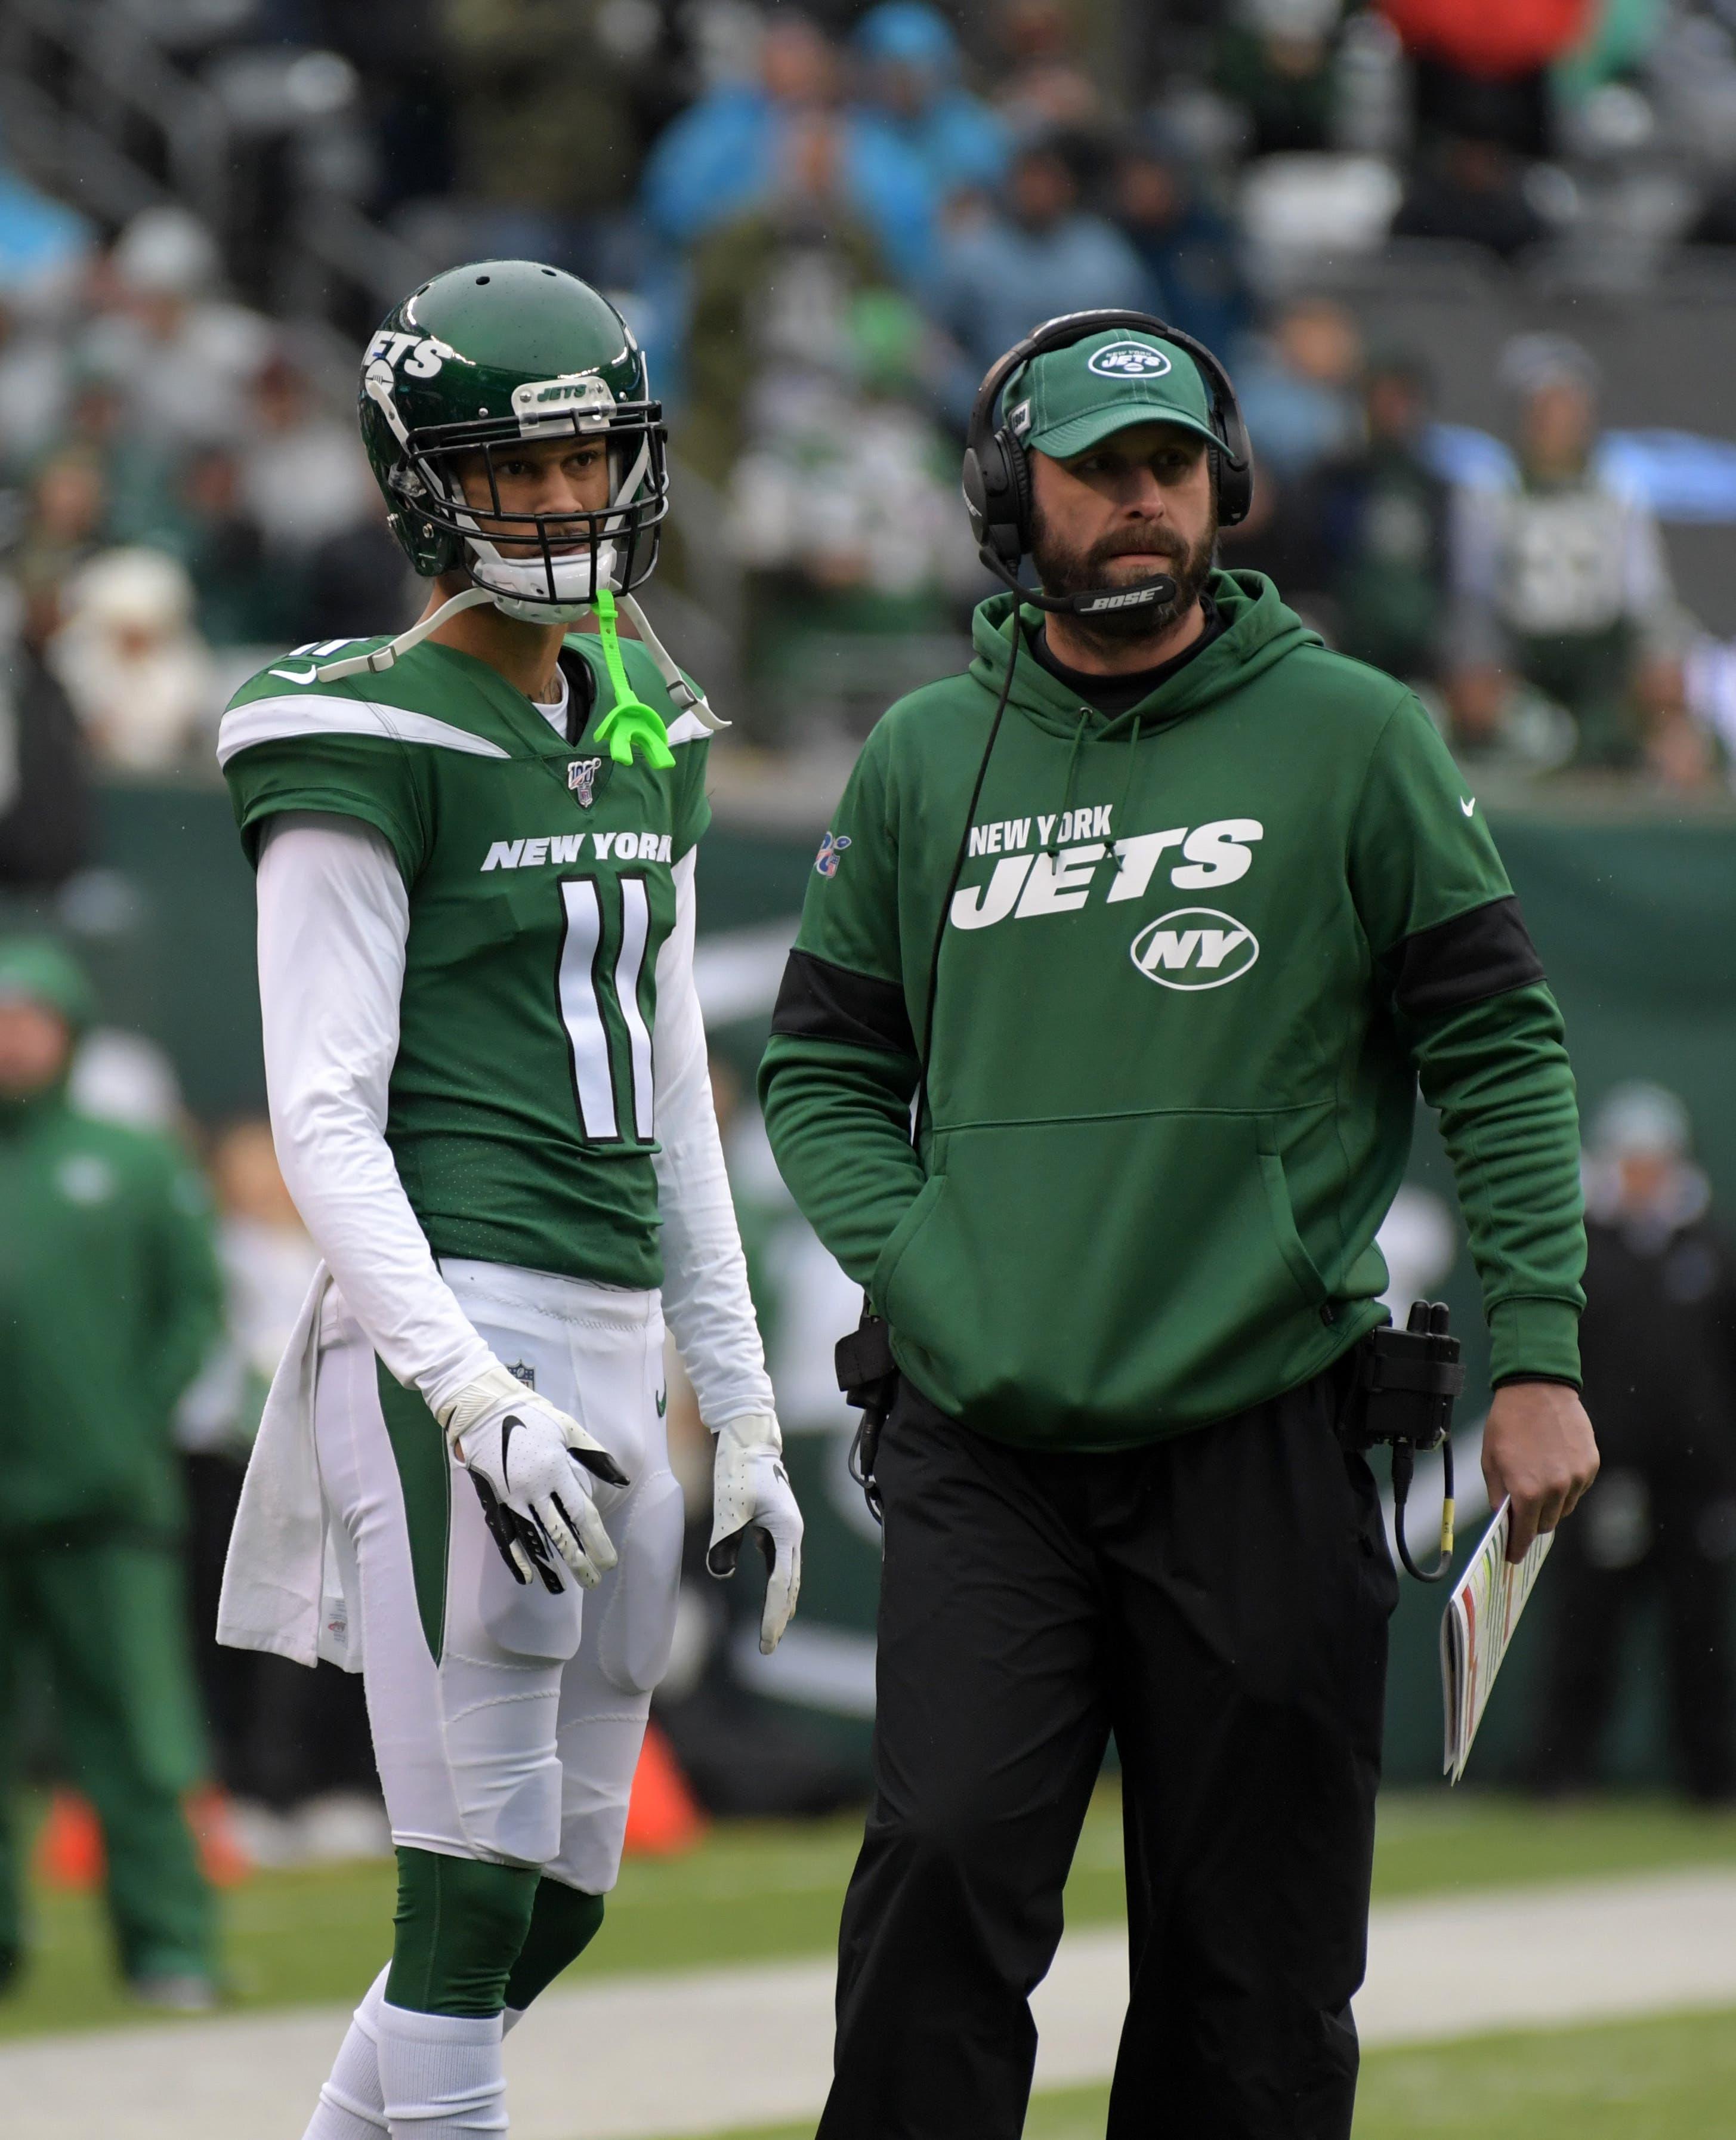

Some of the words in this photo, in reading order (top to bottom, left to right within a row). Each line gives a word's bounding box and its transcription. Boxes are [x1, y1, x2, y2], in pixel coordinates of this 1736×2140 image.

[1101, 354, 1161, 368] JETS
[538, 384, 587, 402] JETS
[1080, 585, 1163, 612] BOSE
[968, 817, 1031, 857] NEW
[1037, 804, 1113, 846] YORK
[480, 833, 586, 872] NEW
[950, 818, 1264, 930] JETS
[1139, 929, 1251, 970] NY
[554, 872, 655, 1145] 11
